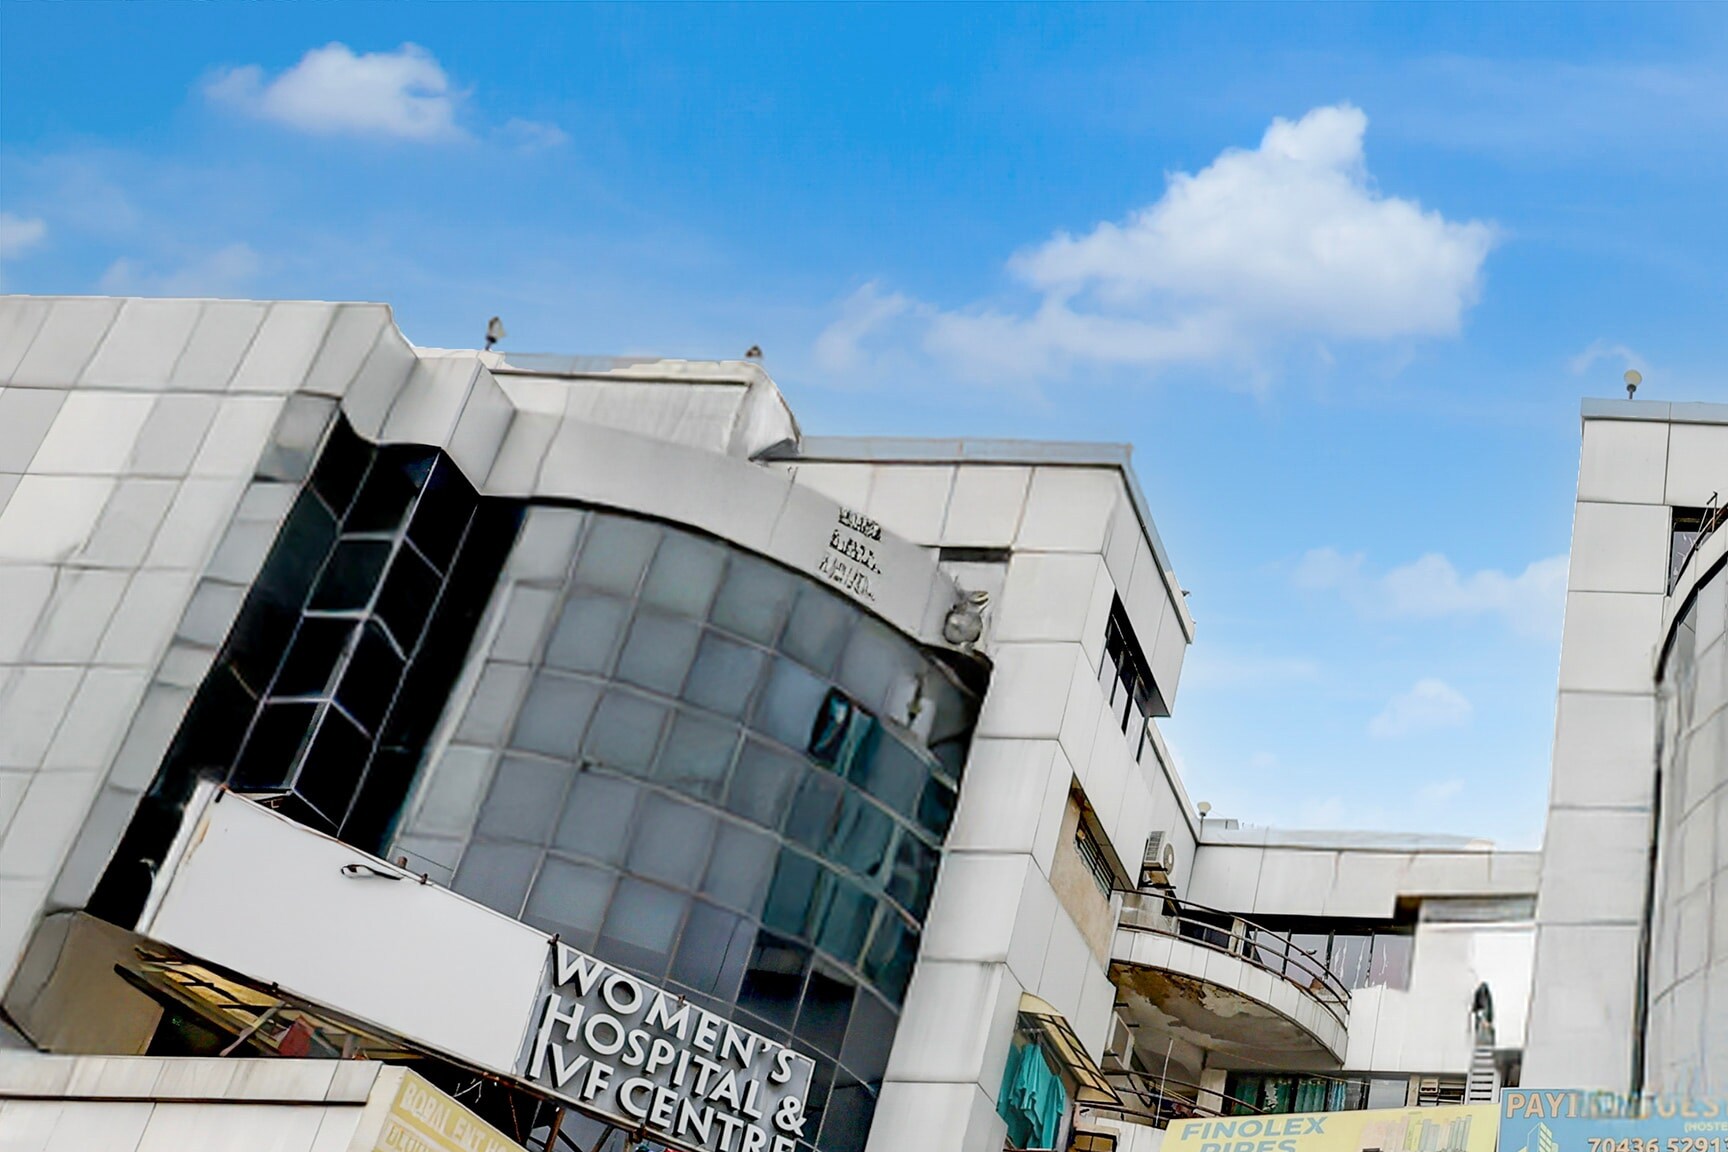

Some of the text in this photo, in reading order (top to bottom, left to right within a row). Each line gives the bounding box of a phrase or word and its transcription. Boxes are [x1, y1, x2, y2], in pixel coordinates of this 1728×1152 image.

[529, 1027, 615, 1101] IVF
[543, 993, 805, 1138] HOSPITAL &
[554, 945, 798, 1083] WOMEN'S
[1180, 1115, 1329, 1140] FINOLEX
